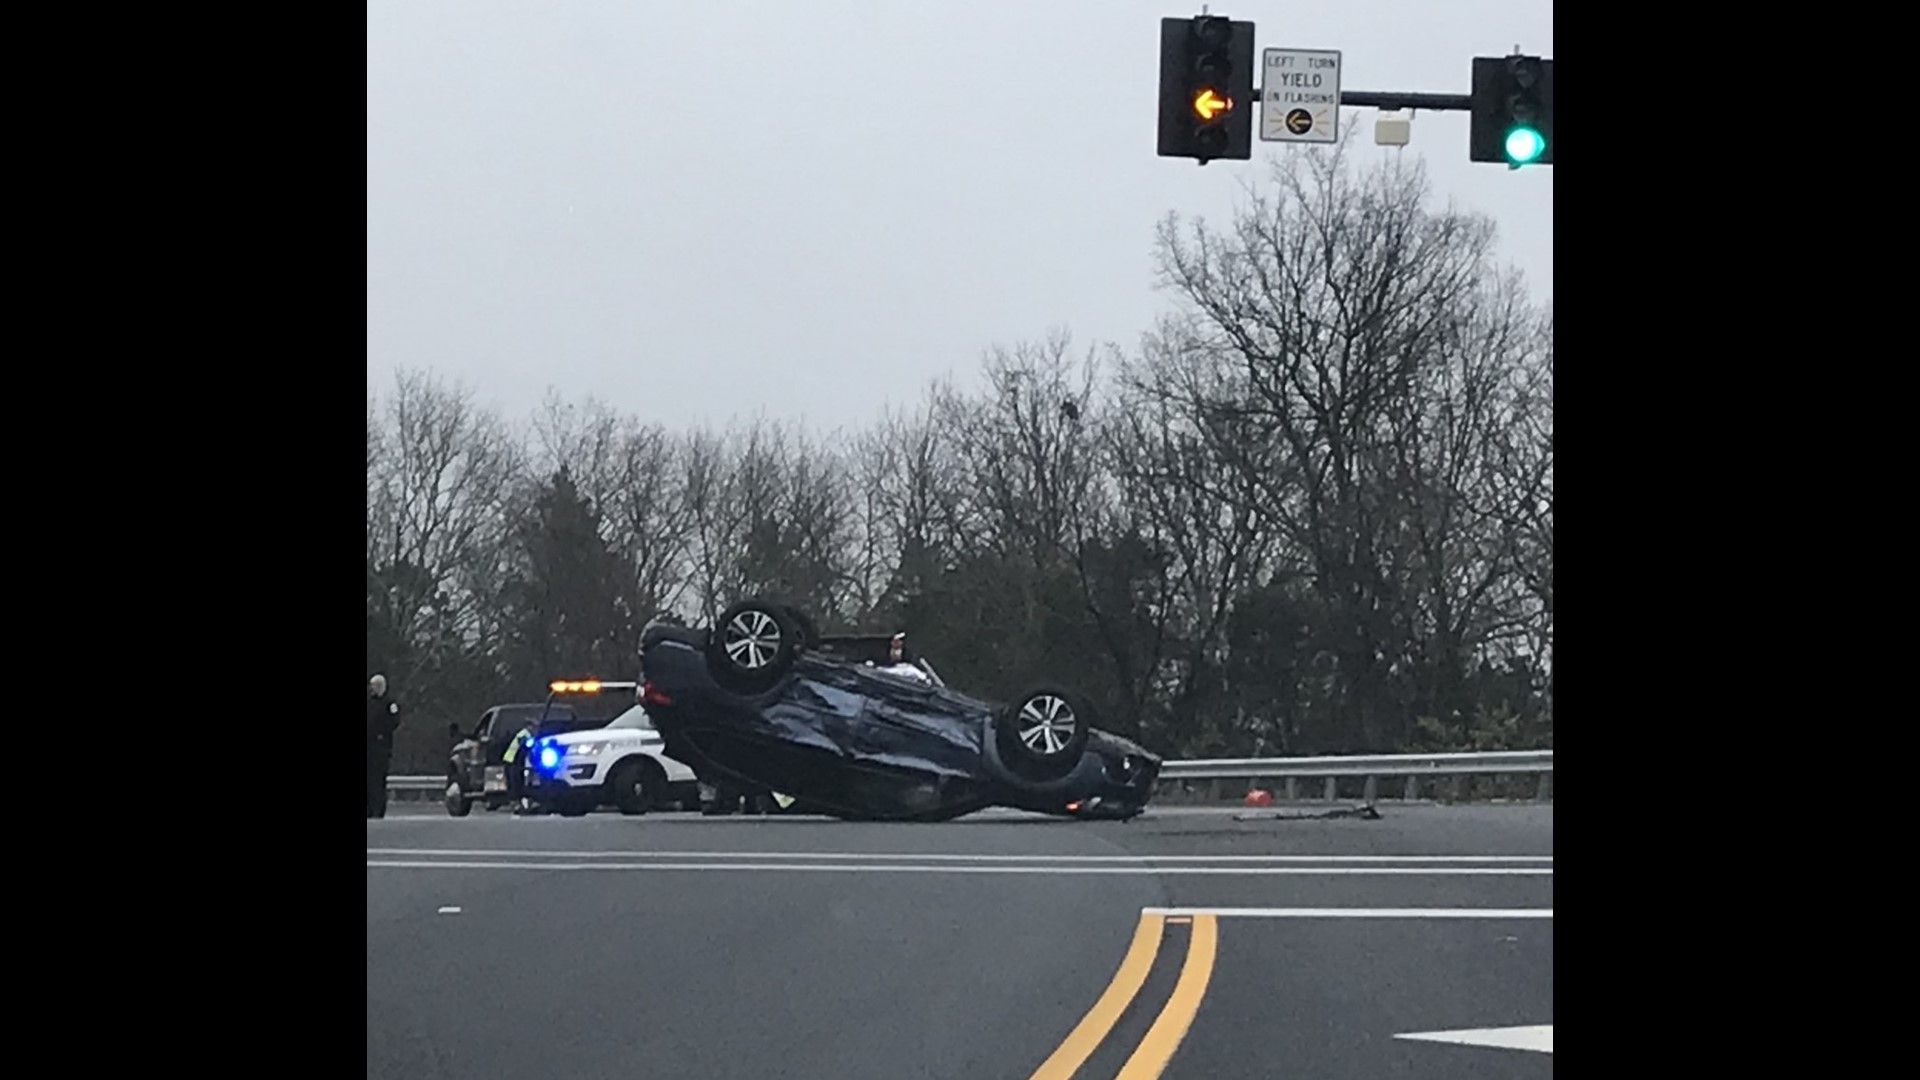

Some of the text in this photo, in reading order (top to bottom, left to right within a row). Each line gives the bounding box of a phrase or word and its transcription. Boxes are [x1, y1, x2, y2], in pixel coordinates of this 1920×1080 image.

[1267, 56, 1336, 69] LEFT TURN
[1281, 72, 1322, 88] YIELD
[1284, 91, 1335, 105] FLASHING
